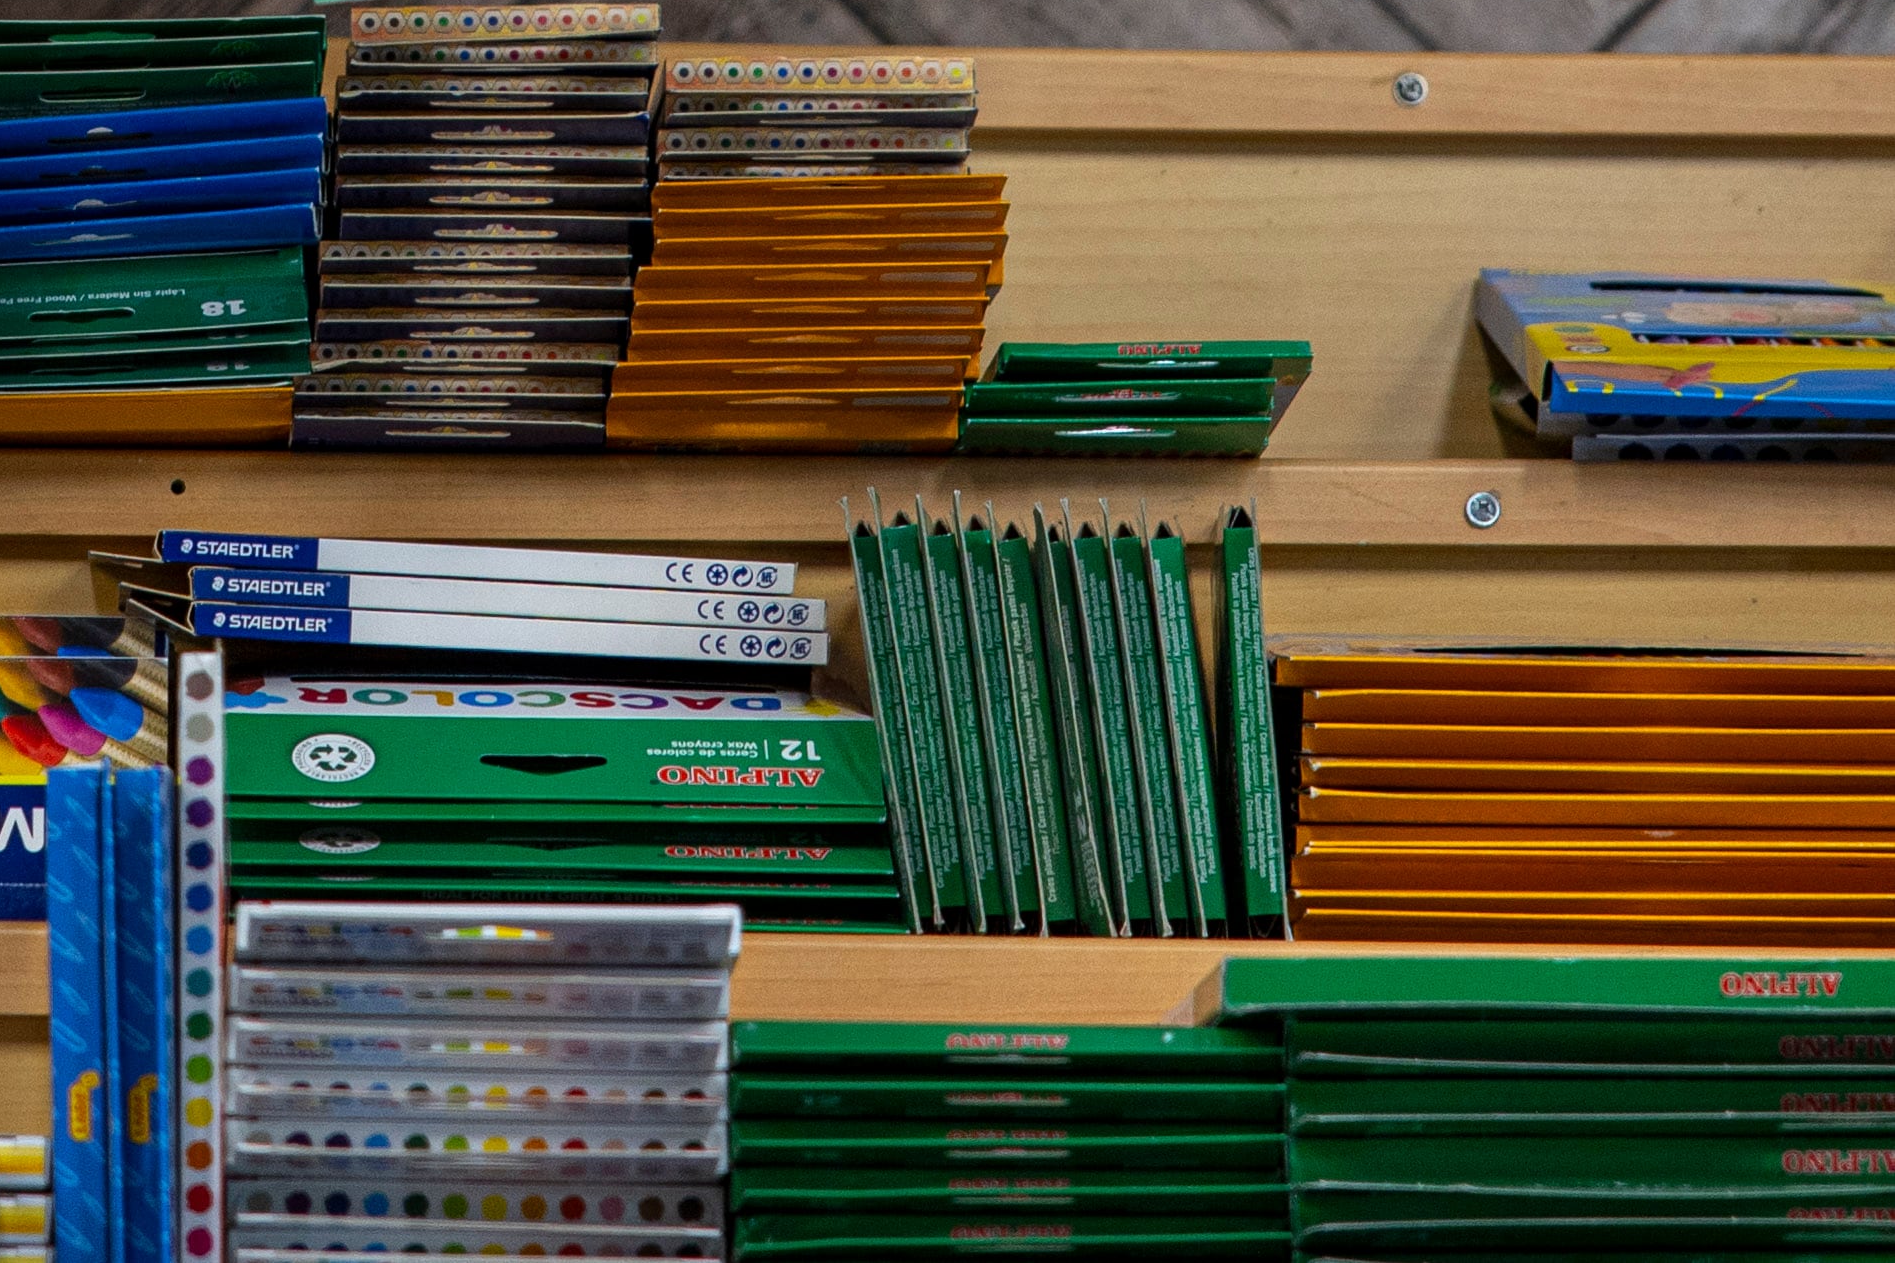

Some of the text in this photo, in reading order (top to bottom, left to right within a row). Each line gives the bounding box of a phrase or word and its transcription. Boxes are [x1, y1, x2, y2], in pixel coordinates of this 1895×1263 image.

[16, 295, 43, 304] Free
[44, 294, 77, 303] Wood
[88, 291, 131, 301] Madera
[133, 290, 152, 299] Sin
[154, 288, 186, 298] Lápiz
[200, 299, 247, 317] 18
[196, 540, 294, 559] STAEDTLER
[665, 562, 694, 583] CE
[227, 578, 326, 597] STAEDTLER
[697, 599, 725, 620] CE
[228, 613, 328, 633] STAEDTLER
[699, 634, 727, 655] CE
[296, 686, 783, 712] DACSCOLOR
[646, 747, 758, 759] Ceras de colores
[671, 739, 758, 750] Wax crayons
[779, 738, 821, 761] 12
[657, 765, 825, 789] ALPINO
[663, 845, 832, 861] ALPINO
[1719, 971, 1842, 997] ALPINO
[1778, 1035, 1895, 1059] ALPINO
[1780, 1093, 1895, 1113] ALPINO
[1781, 1149, 1895, 1174] ALPINO
